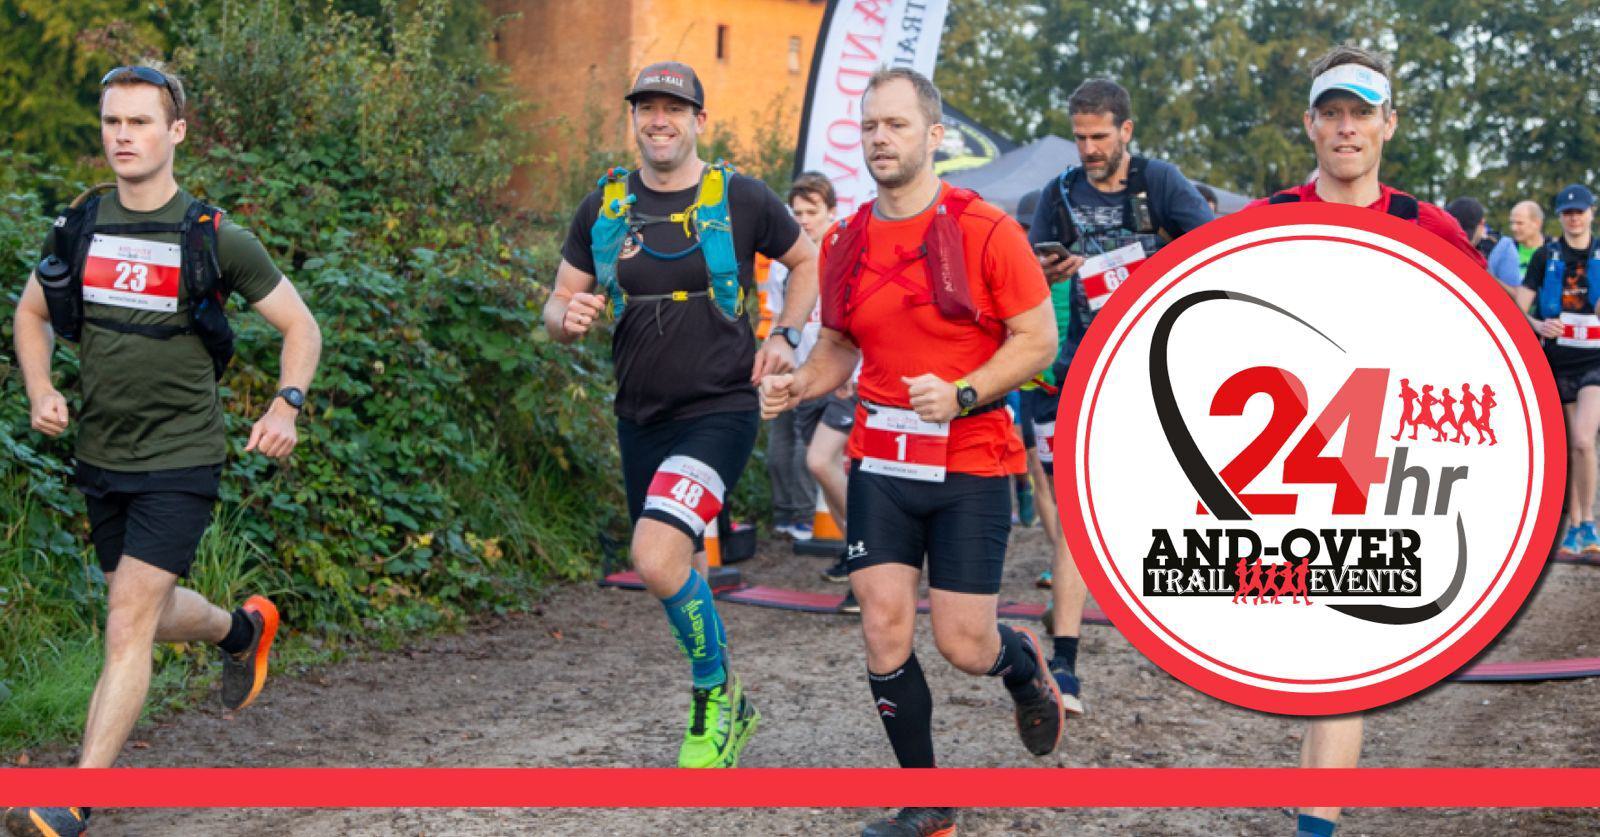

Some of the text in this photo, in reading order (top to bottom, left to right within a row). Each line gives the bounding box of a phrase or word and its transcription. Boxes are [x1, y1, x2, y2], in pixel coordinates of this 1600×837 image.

[113, 261, 148, 292] 23
[895, 433, 907, 462] 1
[671, 478, 704, 509] 48
